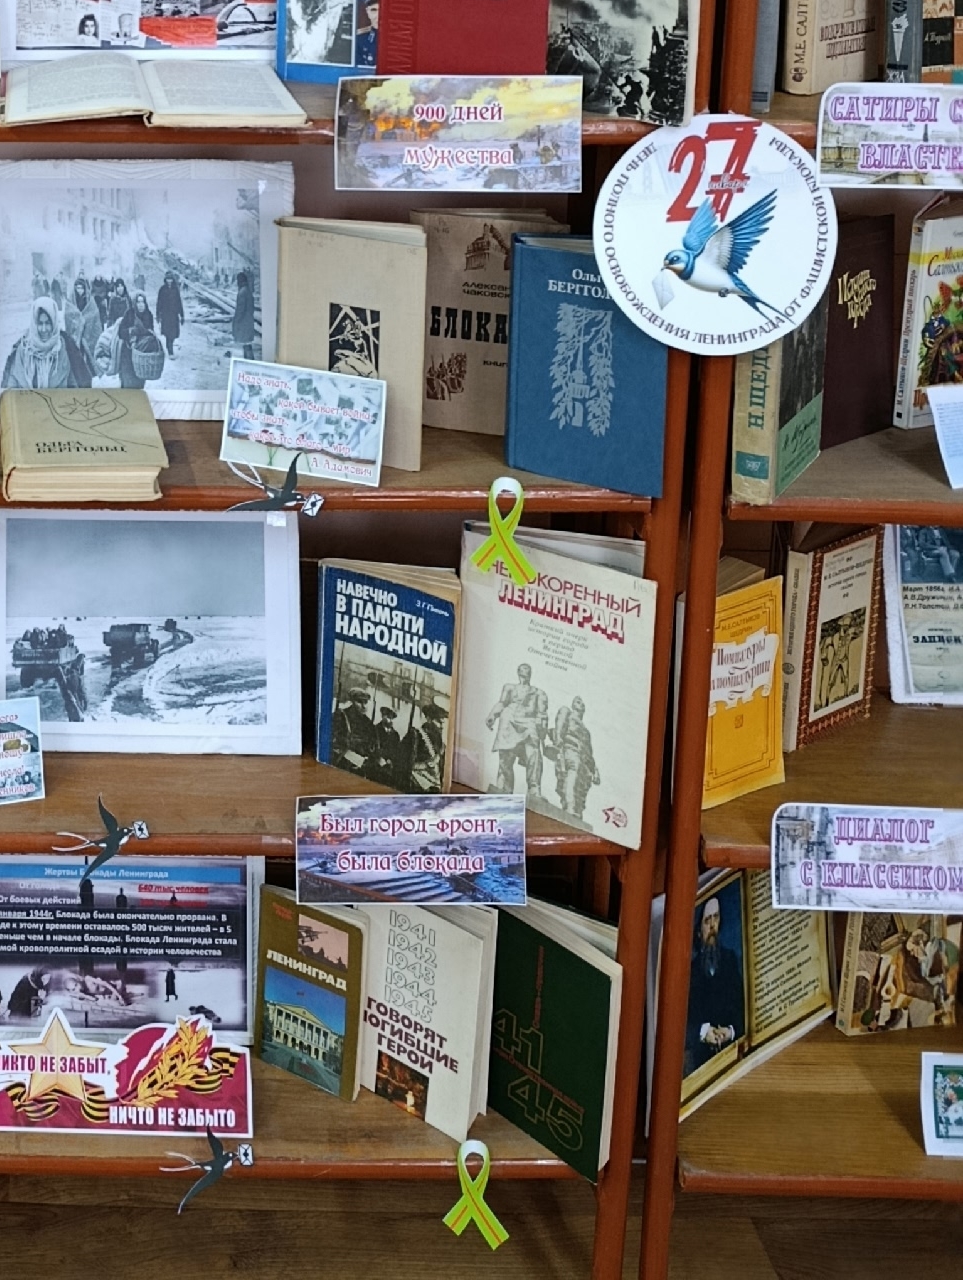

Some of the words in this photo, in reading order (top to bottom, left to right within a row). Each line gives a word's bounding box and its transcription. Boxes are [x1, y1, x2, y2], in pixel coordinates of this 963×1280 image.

[792, 39, 807, 65] М.Е.
[414, 104, 446, 122] 900
[449, 103, 504, 124] дней
[829, 95, 940, 123] САТИРЫ
[402, 145, 515, 172] мужества
[625, 140, 659, 173] ДЕНЬ
[664, 120, 763, 224] 27
[602, 171, 630, 244] ПОЛНОГО
[800, 195, 830, 300] ФАШИСТСКОЙ
[604, 247, 690, 342] ОСВОБОЖДЕНИЯ
[784, 297, 803, 319] ОТ
[430, 305, 509, 345] БЛОКА
[693, 316, 786, 346] ЛЕНИНГРАДА
[335, 578, 399, 609] НАВЕЧНО
[335, 598, 347, 614] В
[351, 600, 425, 636] ПАМЯТИ
[498, 578, 626, 645] ЛЕНИНГРАД
[334, 614, 448, 668] НАРОДНОЙ
[319, 812, 364, 833] Был
[368, 812, 503, 842] город-фронт,
[833, 816, 935, 846] ДИАЛОГ
[44, 867, 78, 877] Жертвы
[118, 869, 169, 879] Ленинграда
[336, 849, 392, 872] была
[395, 849, 485, 875] блокада
[799, 862, 814, 887] С
[9, 895, 41, 904] боевых
[41, 896, 82, 906] действий
[55, 910, 91, 920] Блокада
[93, 911, 115, 920] была
[116, 912, 176, 922] окончательно
[125, 933, 161, 944] Блокада
[161, 935, 213, 946] Ленинграда
[388, 908, 437, 946] 1941
[90, 945, 122, 955] осадой
[129, 946, 165, 956] истории
[165, 947, 223, 957] человечества
[387, 927, 438, 969] 1942
[265, 948, 348, 992] ЛЕНИНГРАД
[386, 947, 437, 986] 1943
[384, 967, 438, 1006] 1944
[383, 984, 434, 1024] 1945
[366, 995, 448, 1050] ГОВОРЯТ
[39, 1054, 57, 1073] НЕ
[376, 1032, 434, 1075] ГЕРОИ
[108, 1105, 155, 1126] НИЧТО
[157, 1107, 176, 1126] НЕ
[177, 1107, 237, 1128] ЗАБЫТО
[507, 1074, 584, 1151] 45
